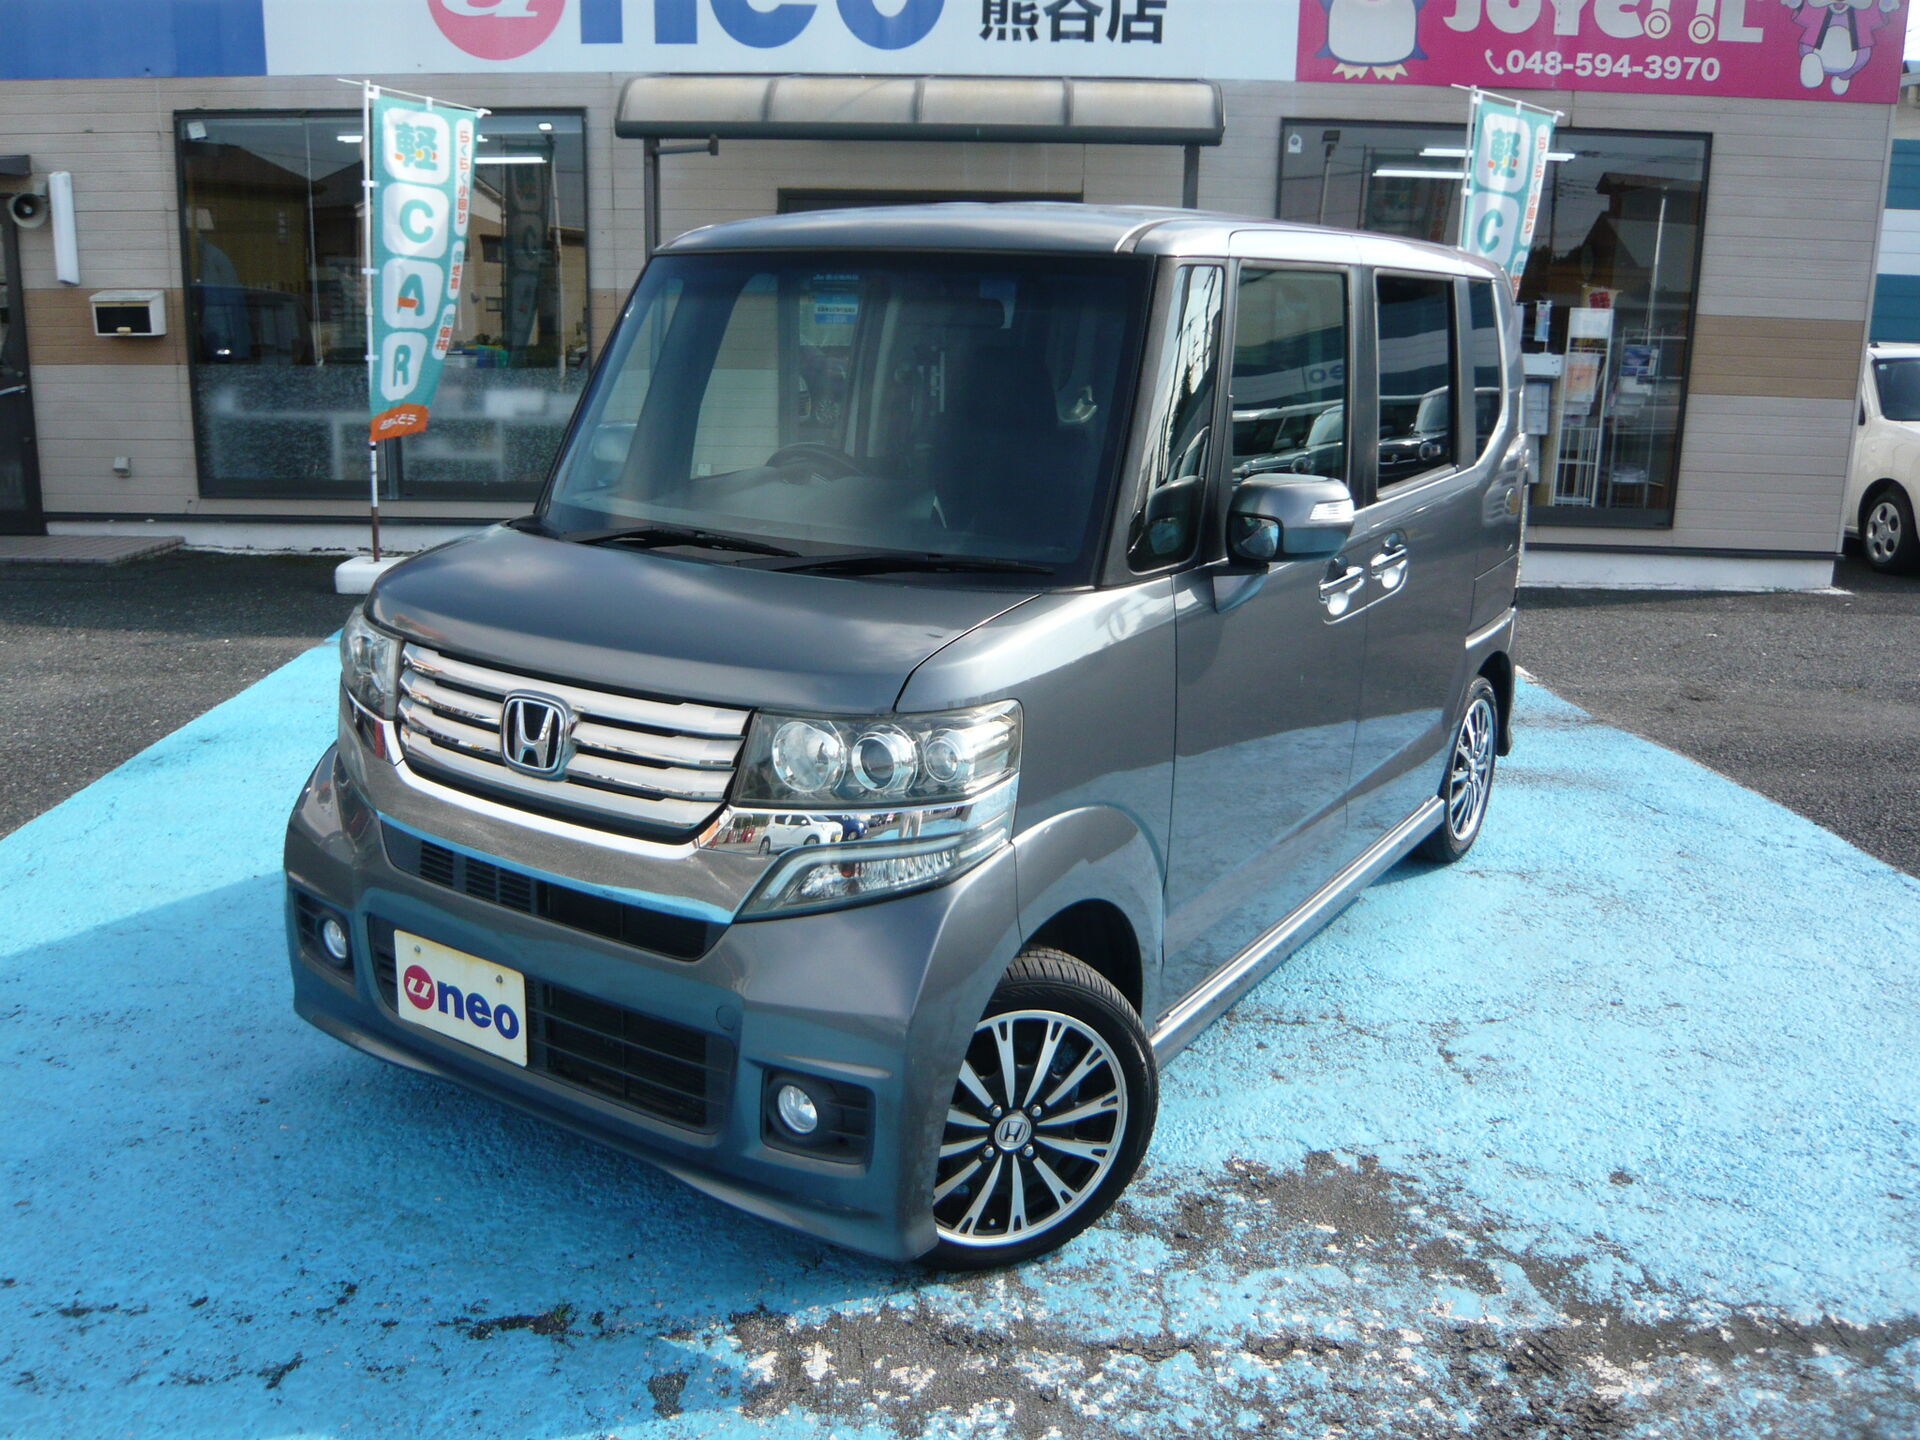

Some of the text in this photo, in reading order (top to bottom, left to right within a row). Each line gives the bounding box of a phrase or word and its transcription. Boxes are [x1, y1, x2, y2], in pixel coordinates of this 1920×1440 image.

[979, 0, 1168, 44] 熊谷店
[1505, 49, 1721, 82] 048-594-3970
[403, 964, 520, 1040] uneo
